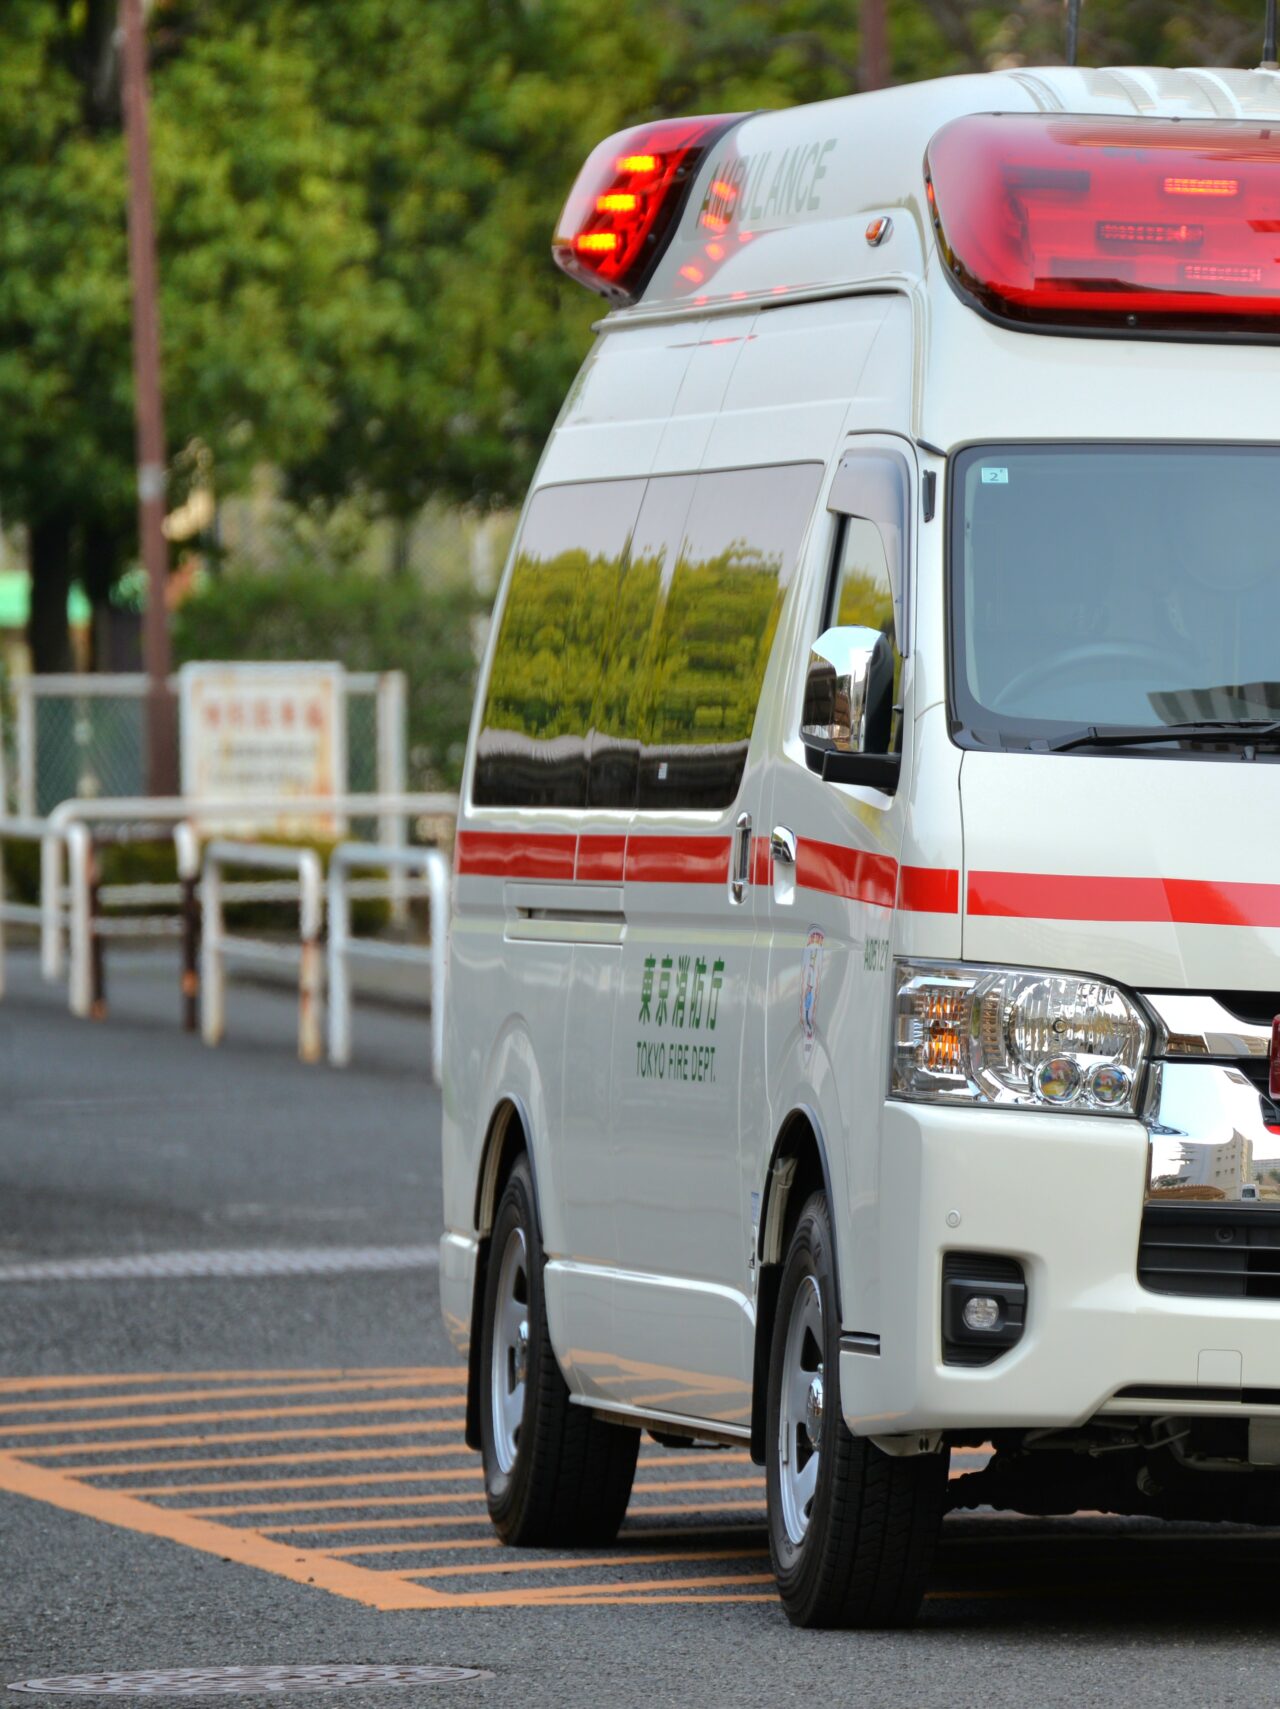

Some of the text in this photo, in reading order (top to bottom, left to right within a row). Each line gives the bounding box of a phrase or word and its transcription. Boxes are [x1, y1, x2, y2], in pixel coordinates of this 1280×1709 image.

[696, 138, 838, 230] AMBULANCE
[639, 954, 725, 1030] 東京消防庁
[636, 1041, 716, 1083] TOKYO FIRE DEPT.
